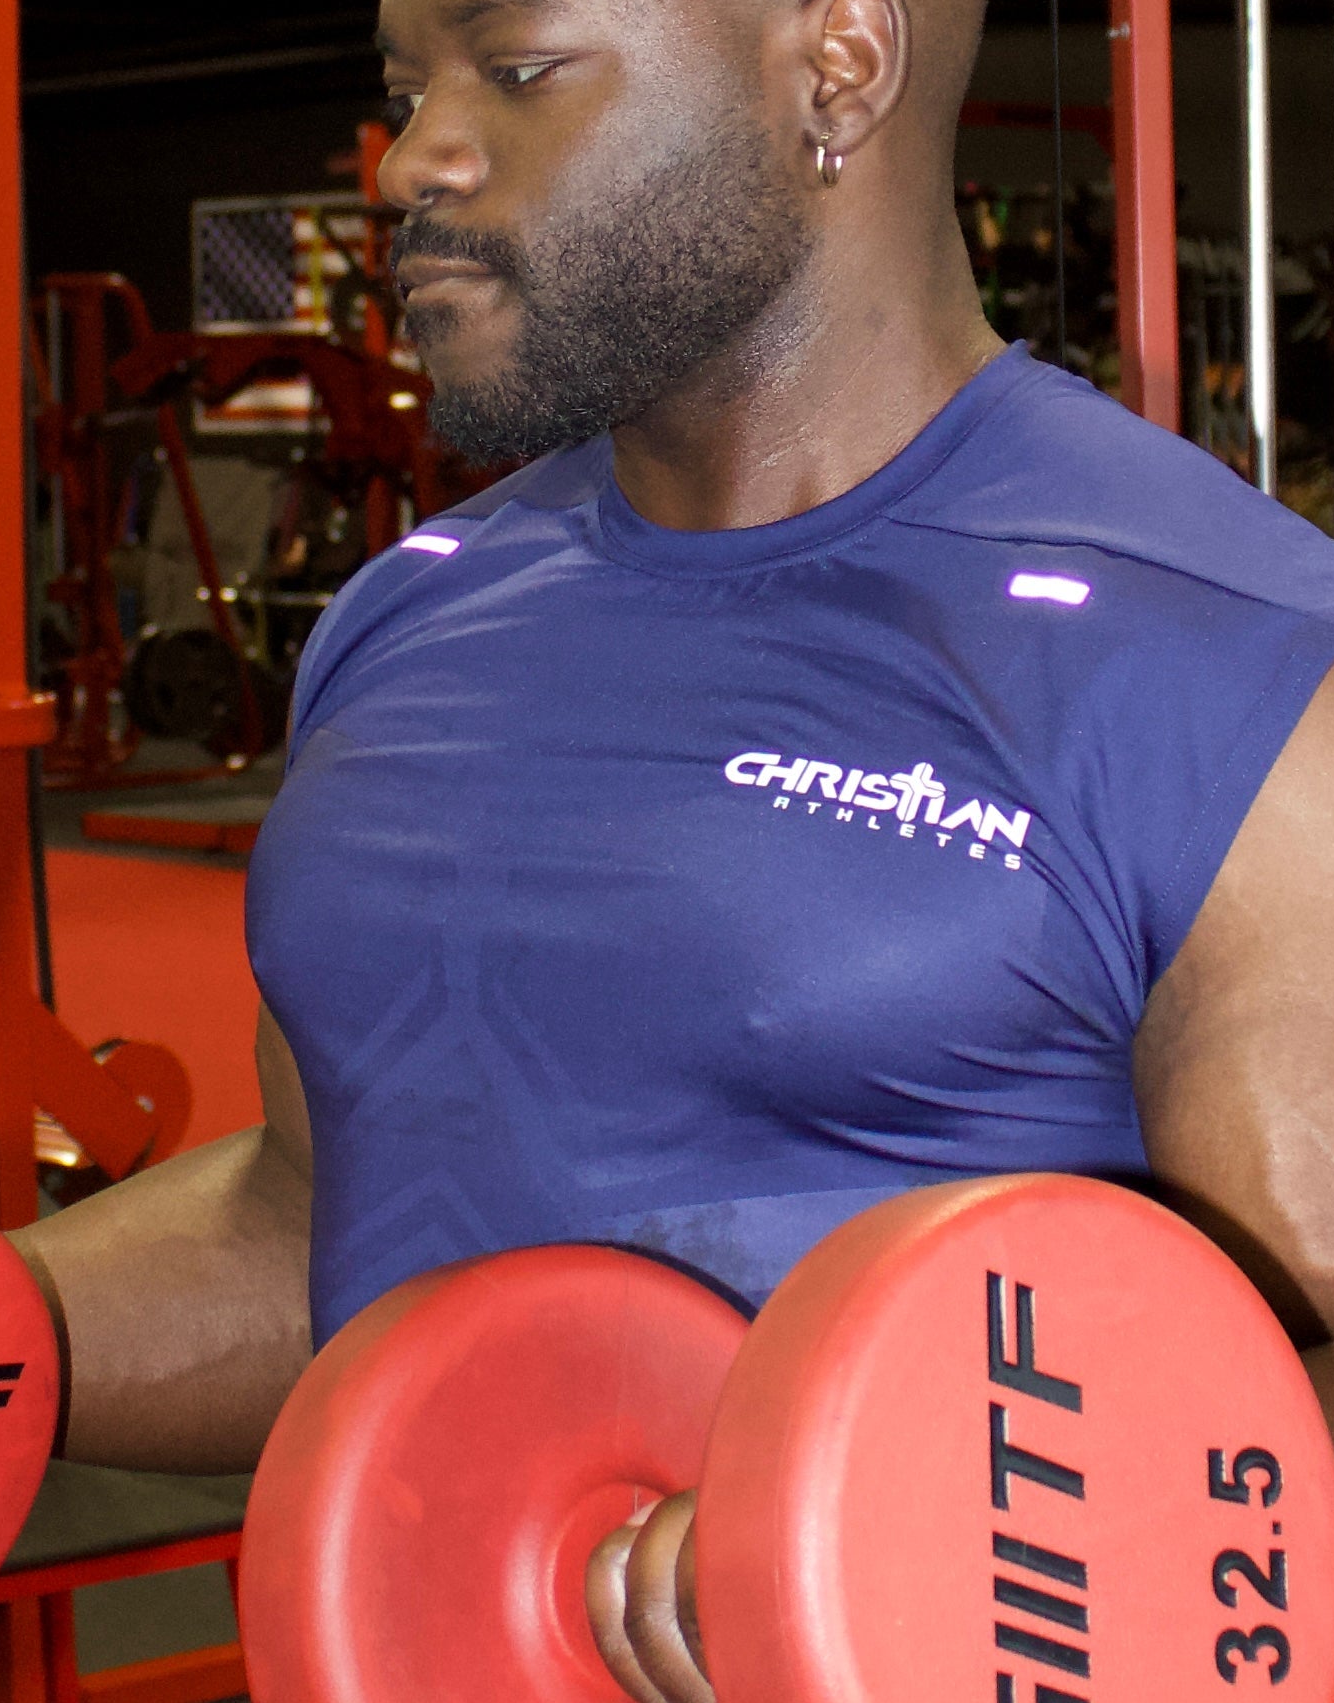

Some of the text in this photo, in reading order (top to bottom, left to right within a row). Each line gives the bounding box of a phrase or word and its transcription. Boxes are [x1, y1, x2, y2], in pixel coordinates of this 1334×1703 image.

[724, 752, 1031, 848] CHRISTIAN
[773, 796, 1021, 870] ATHLETES
[1207, 1445, 1292, 1686] 32.5
